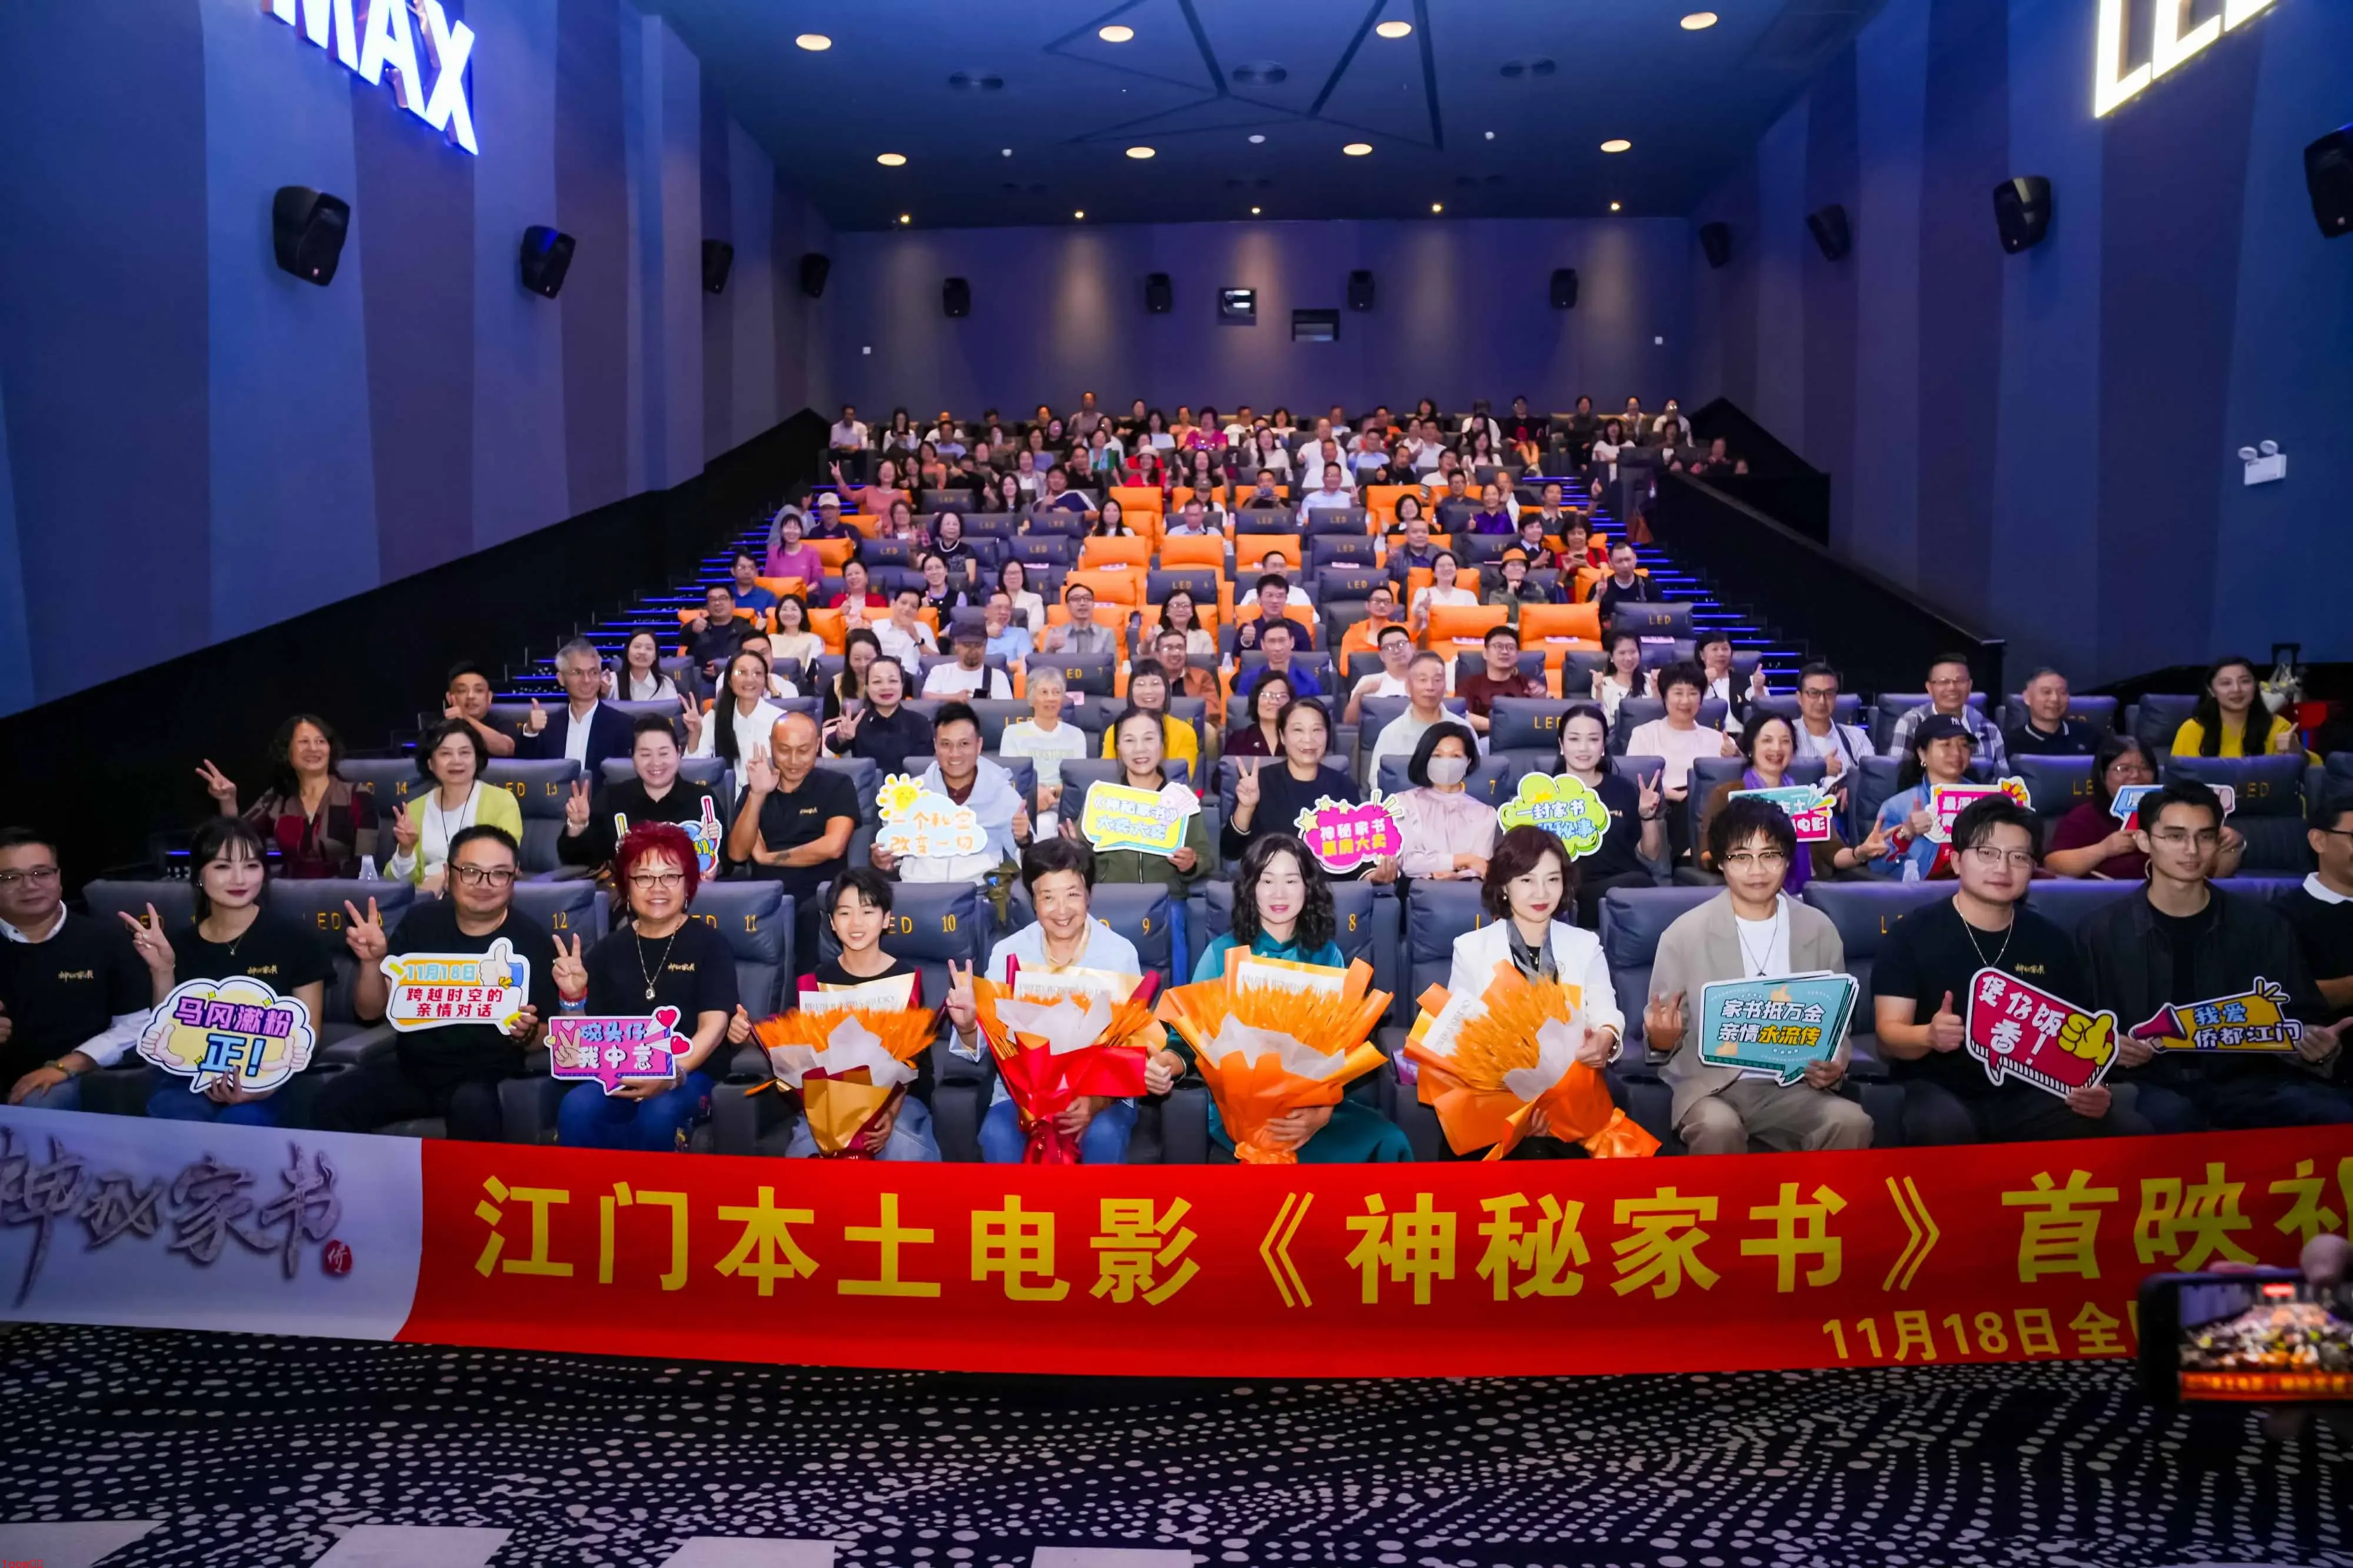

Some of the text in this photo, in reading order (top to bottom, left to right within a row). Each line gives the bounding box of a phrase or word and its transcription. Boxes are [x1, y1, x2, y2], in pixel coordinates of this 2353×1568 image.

[1172, 580, 1192, 590] LED
[1347, 579, 1367, 589] LED
[1649, 615, 1671, 625] LED
[1066, 668, 1083, 679] ED
[395, 780, 408, 795] 14
[546, 782, 557, 795] 13
[1489, 779, 1496, 795] 7
[2073, 779, 2094, 795] LE
[1516, 799, 1586, 820] 一封家书
[1320, 818, 1385, 841] 神秘家书
[317, 912, 342, 930] ED
[552, 912, 568, 930] 12
[745, 914, 758, 932] 11
[888, 914, 956, 934] ED 10
[1142, 918, 1150, 936] 9
[1349, 913, 1357, 932] 8
[406, 963, 476, 981] 11月18日
[406, 987, 503, 1002] 跨越时空的
[416, 1003, 492, 1017] 亲情对话
[1721, 999, 1827, 1023] 家书抵万金
[2194, 1002, 2248, 1026] 我爱
[1718, 1022, 1822, 1047] 亲情永流传
[2194, 1022, 2303, 1049] 侨都江门
[1822, 1301, 2138, 1362] 11月18日全
